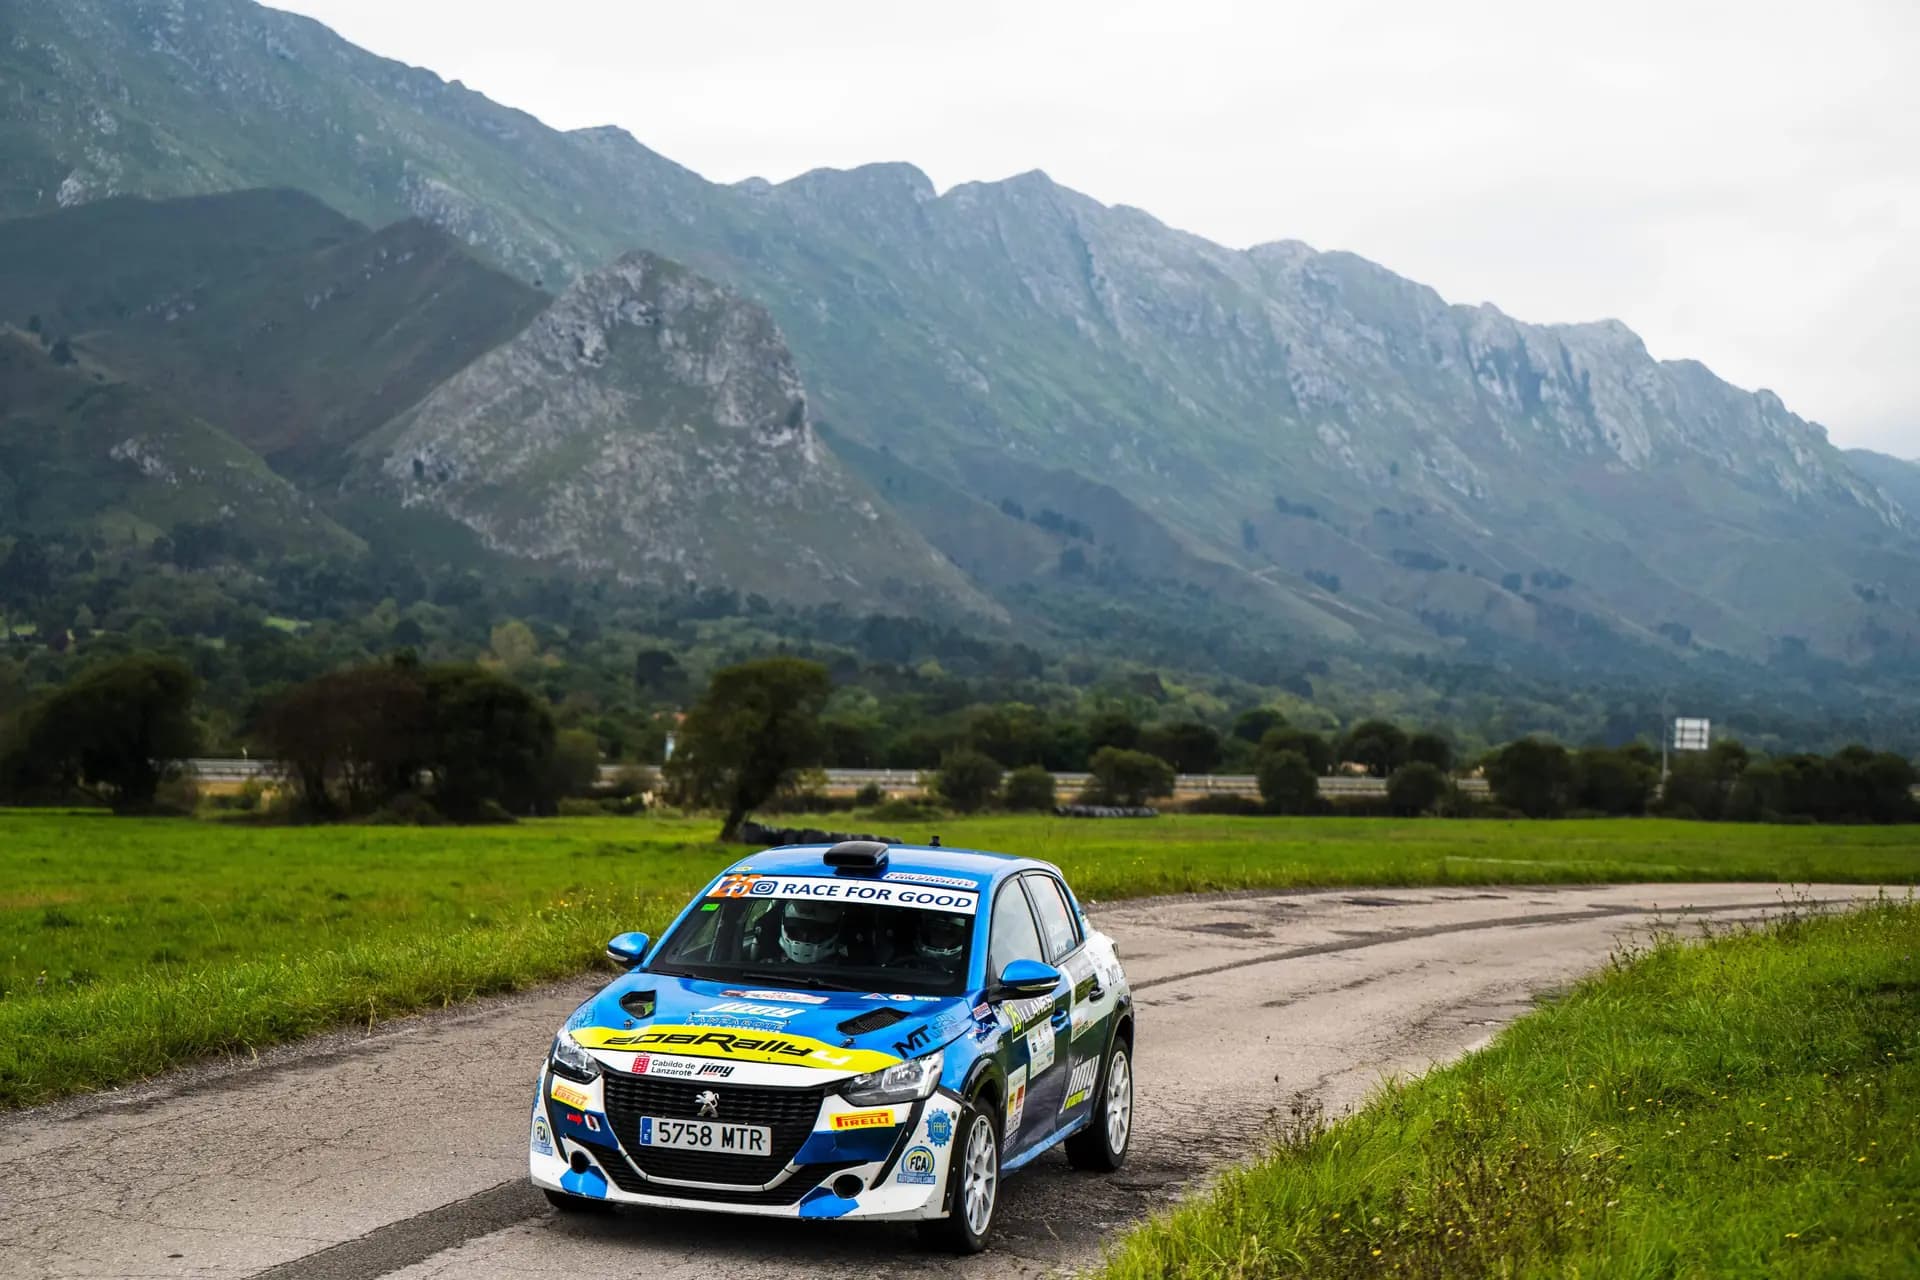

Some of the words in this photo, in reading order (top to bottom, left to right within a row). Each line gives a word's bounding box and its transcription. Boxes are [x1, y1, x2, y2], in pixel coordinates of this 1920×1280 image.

[782, 883, 840, 897] RACE
[845, 886, 892, 900] FOR
[898, 891, 972, 908] GOOD
[892, 1024, 931, 1060] MT
[651, 1067, 693, 1077] Lanzarote
[652, 1059, 683, 1069] Cabildo
[685, 1062, 696, 1070] de
[554, 1085, 588, 1107] PIRELLI
[835, 1112, 889, 1128] PIRELLI
[658, 1121, 713, 1147] 5758
[721, 1126, 763, 1151] MTR
[910, 1155, 928, 1171] FCA
